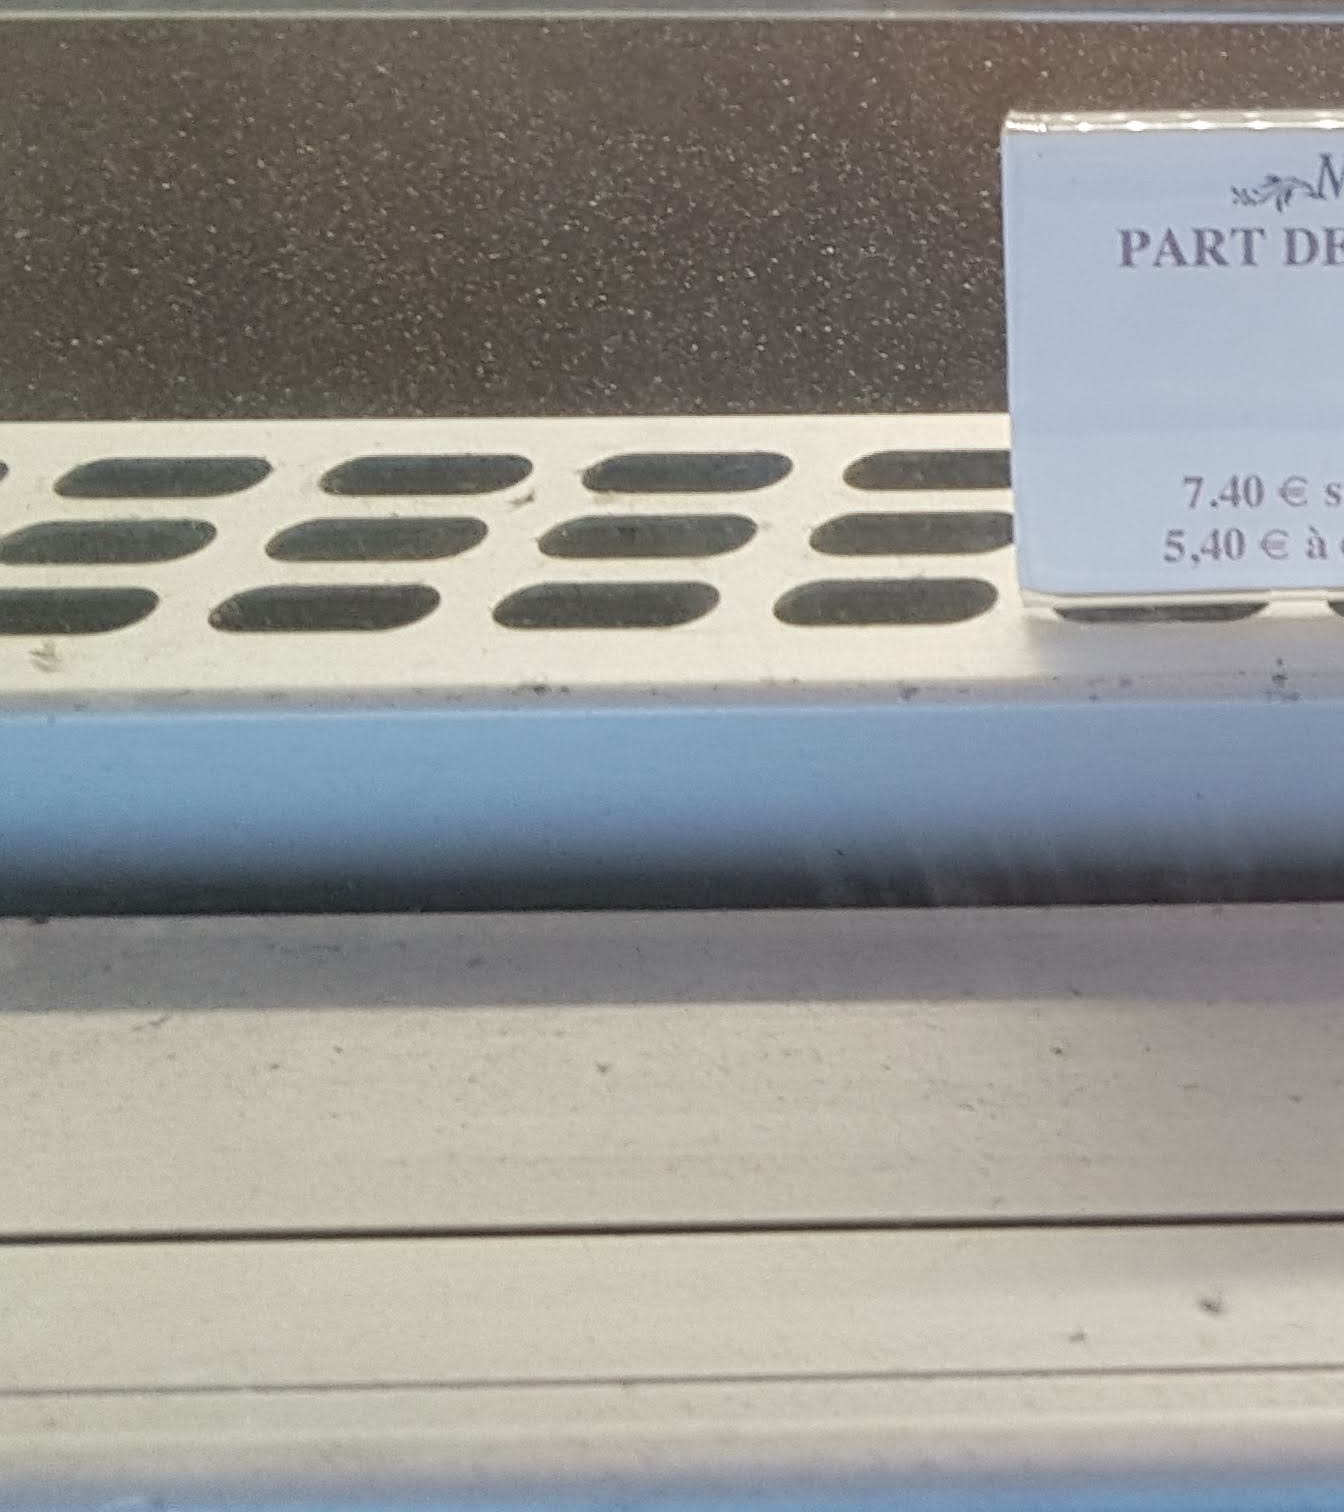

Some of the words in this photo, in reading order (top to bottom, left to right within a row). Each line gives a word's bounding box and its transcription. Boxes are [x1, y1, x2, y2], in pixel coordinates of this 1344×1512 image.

[1118, 227, 1266, 269] PART
[1279, 474, 1309, 508] €
[1260, 528, 1291, 561] €
[1306, 525, 1330, 561] à
